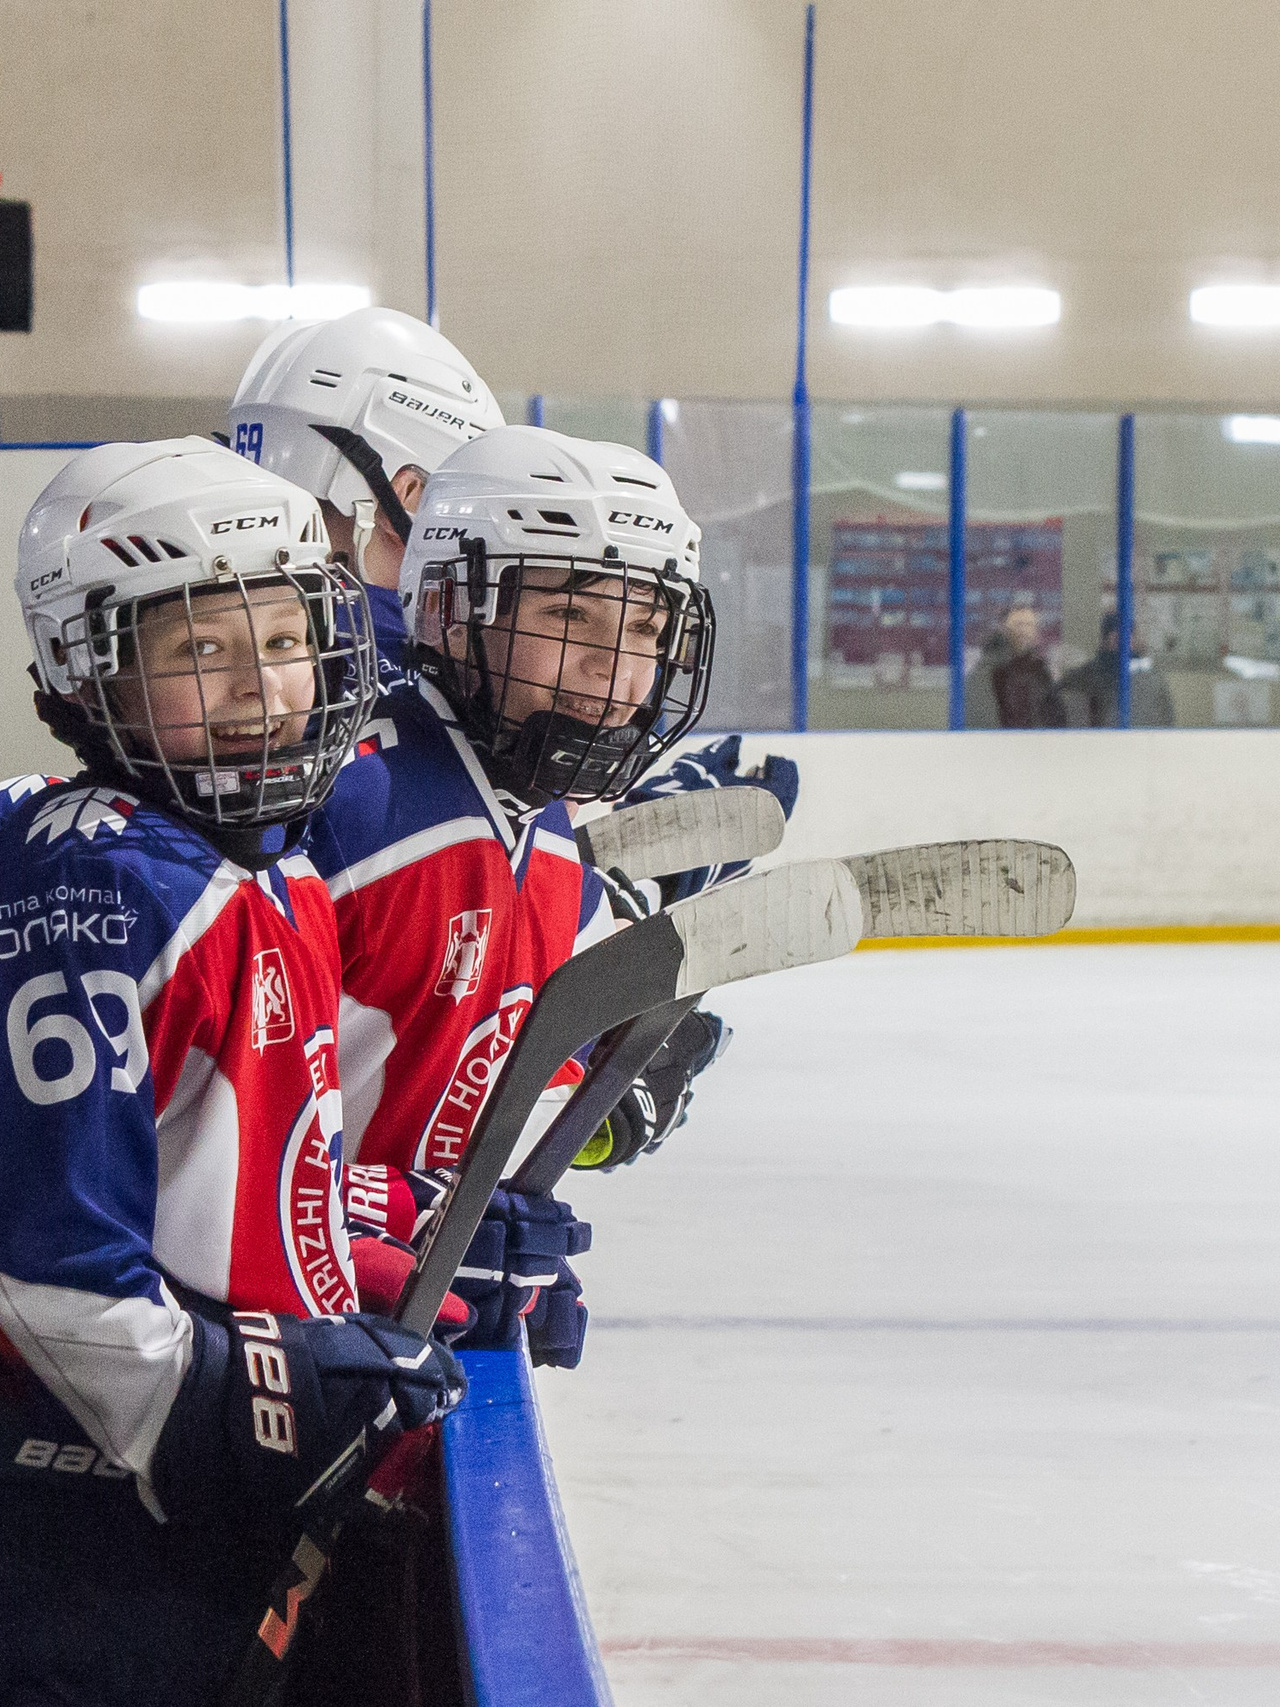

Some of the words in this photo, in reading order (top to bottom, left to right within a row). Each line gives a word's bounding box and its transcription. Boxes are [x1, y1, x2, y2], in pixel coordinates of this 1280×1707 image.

[211, 516, 279, 535] CCM
[423, 527, 469, 540] CCM
[608, 510, 674, 534] CCM
[31, 567, 63, 592] CCM
[6, 969, 150, 1106] 69
